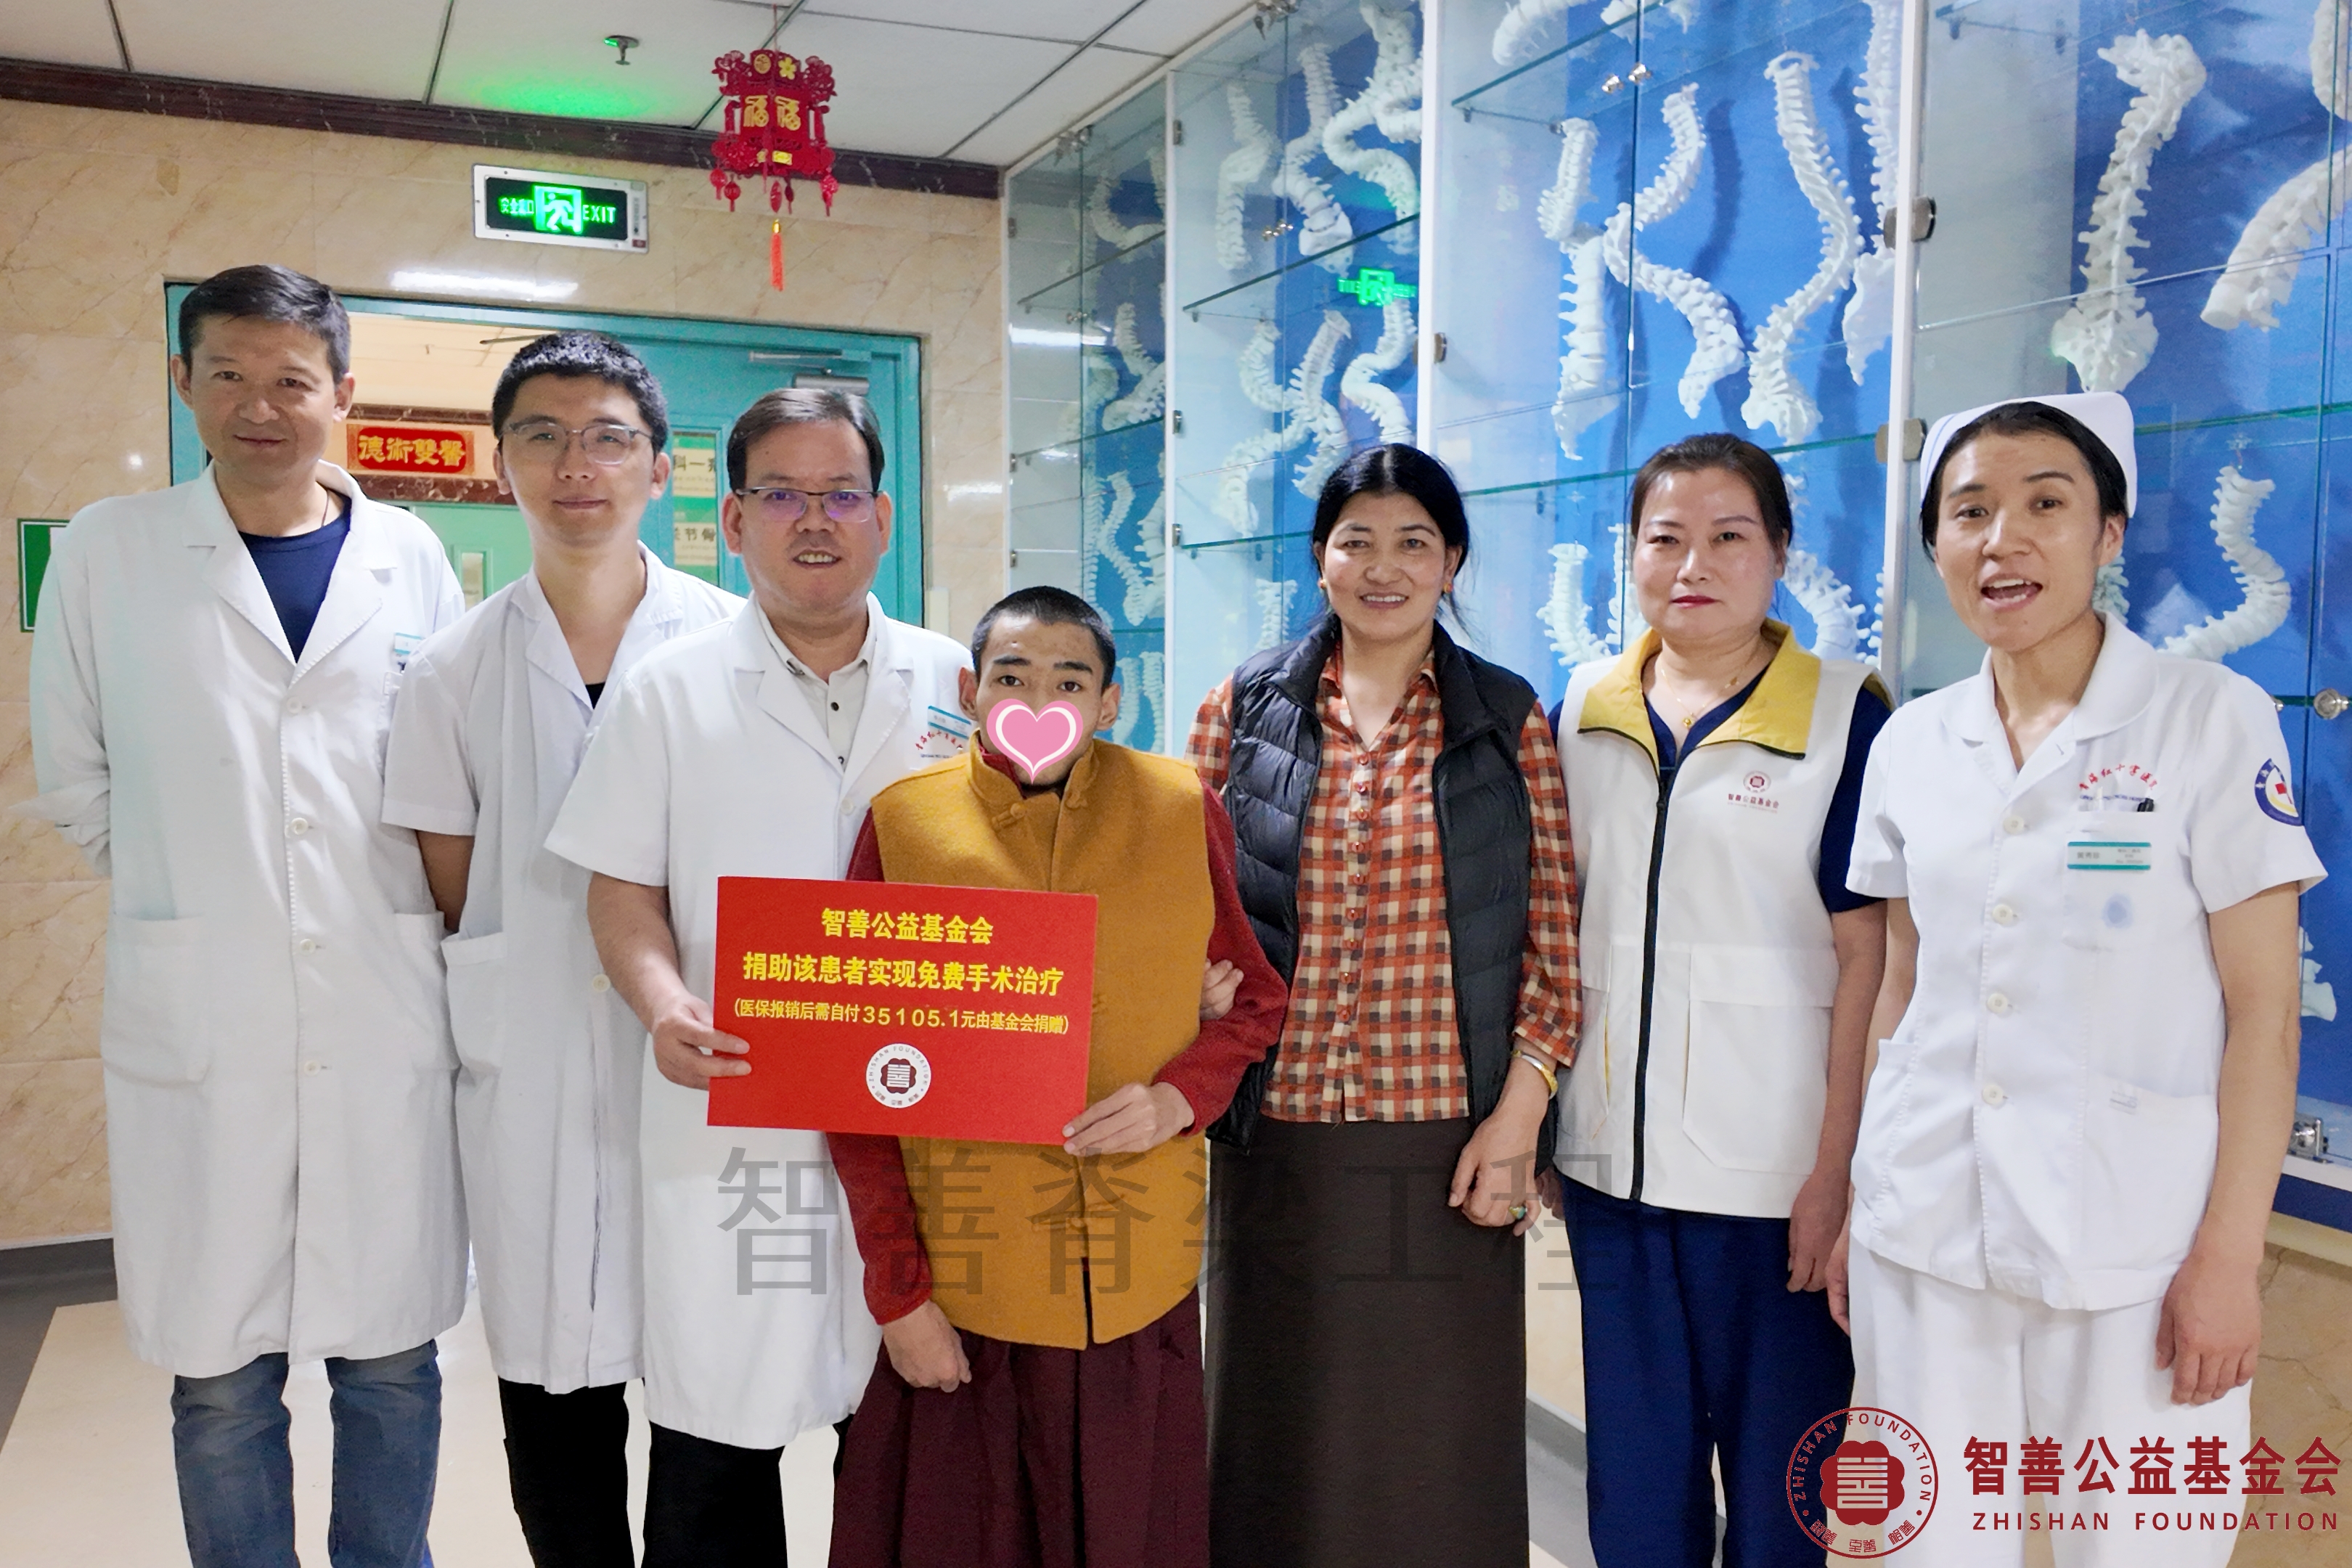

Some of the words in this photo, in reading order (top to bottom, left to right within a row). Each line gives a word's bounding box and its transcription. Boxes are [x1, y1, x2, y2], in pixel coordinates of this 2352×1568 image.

[582, 204, 616, 224] EXIT
[822, 907, 994, 944] 智善公益基金会
[743, 952, 1064, 996] 捐助该患者实现免费手术治疗
